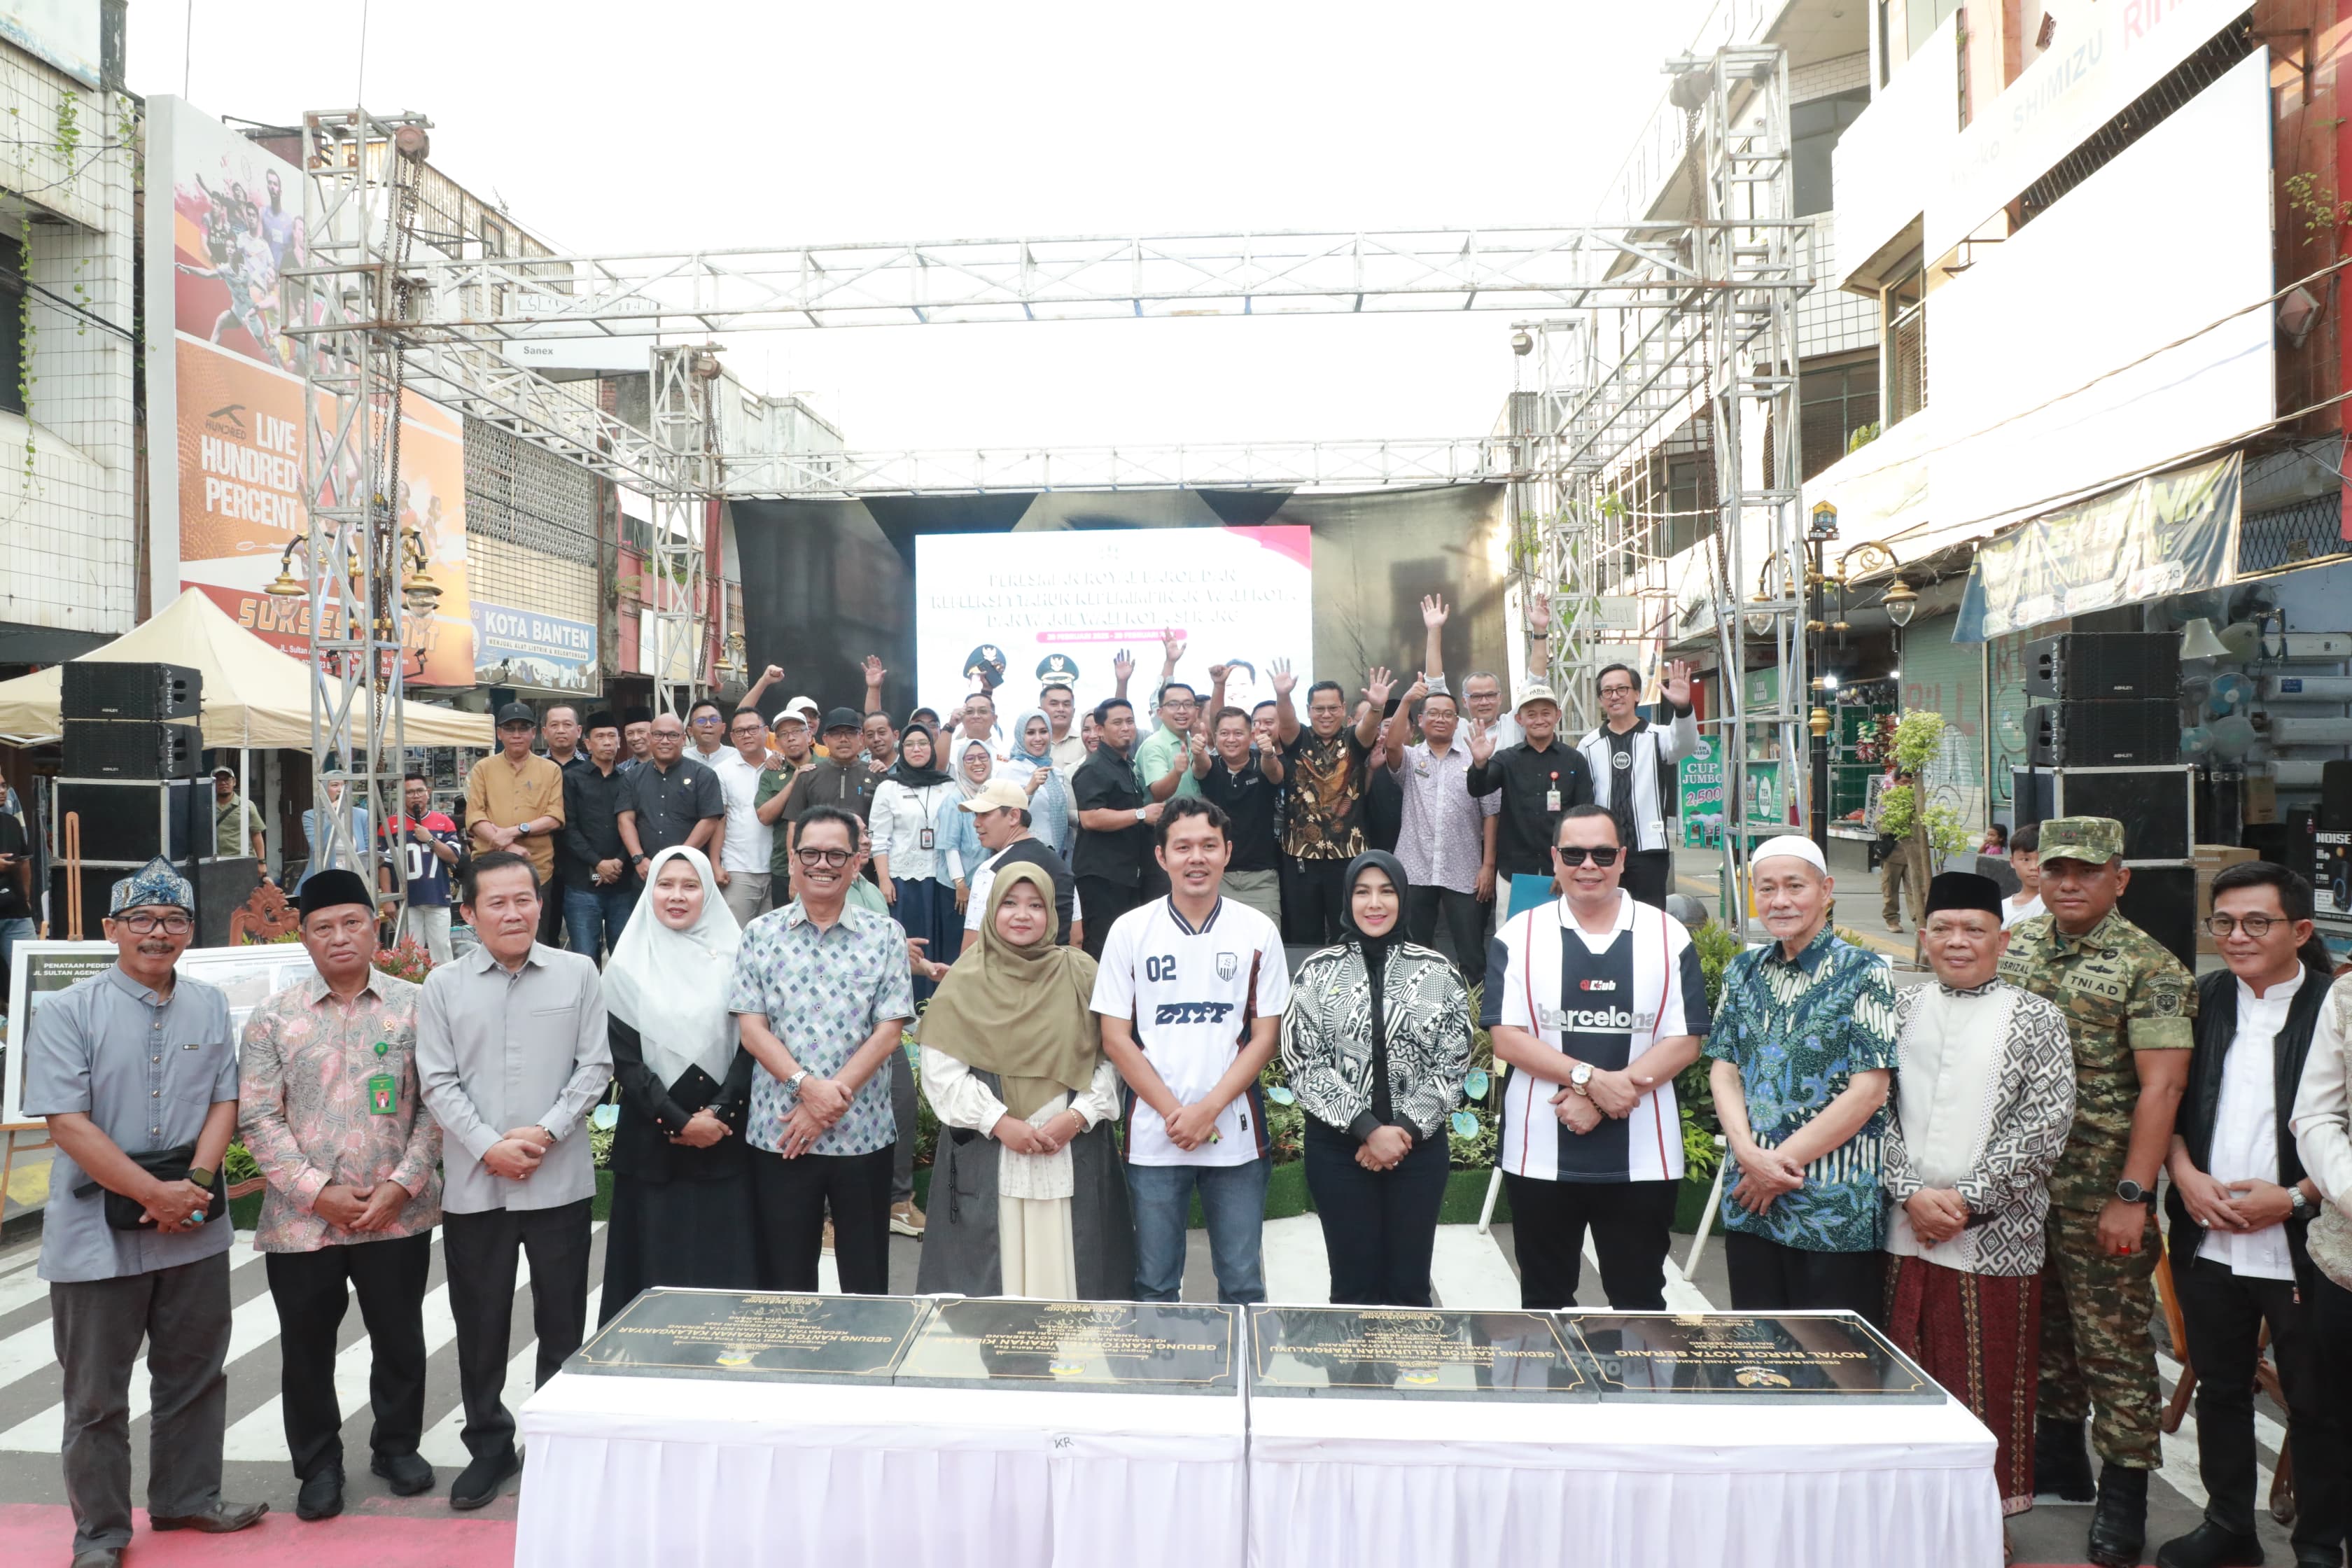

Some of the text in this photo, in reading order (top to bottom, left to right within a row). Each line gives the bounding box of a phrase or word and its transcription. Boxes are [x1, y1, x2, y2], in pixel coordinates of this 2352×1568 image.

[2012, 28, 2104, 134] SHIMIZU
[524, 346, 553, 355] Sanex
[205, 419, 246, 440] HUNDRED
[256, 412, 297, 456] LIVE
[201, 434, 298, 493] HUNDRED
[205, 475, 298, 531] PERCENT
[485, 610, 589, 650] KOTA BANTEN
[289, 645, 308, 654] Sultan
[489, 638, 512, 648] MENJUAL
[1687, 763, 1718, 774] CUP
[2316, 832, 2352, 844] NOISE
[1146, 955, 1177, 982] 02
[2071, 976, 2119, 995] TNI AD
[1538, 1003, 1656, 1032] barcelona
[618, 1326, 710, 1336] KALANGANYAR
[711, 1331, 785, 1340] KELURAHAN
[1000, 1339, 1087, 1348] KELURAHAN
[1270, 1346, 1353, 1354] MARGALUYU
[1055, 1436, 1074, 1449] KR
